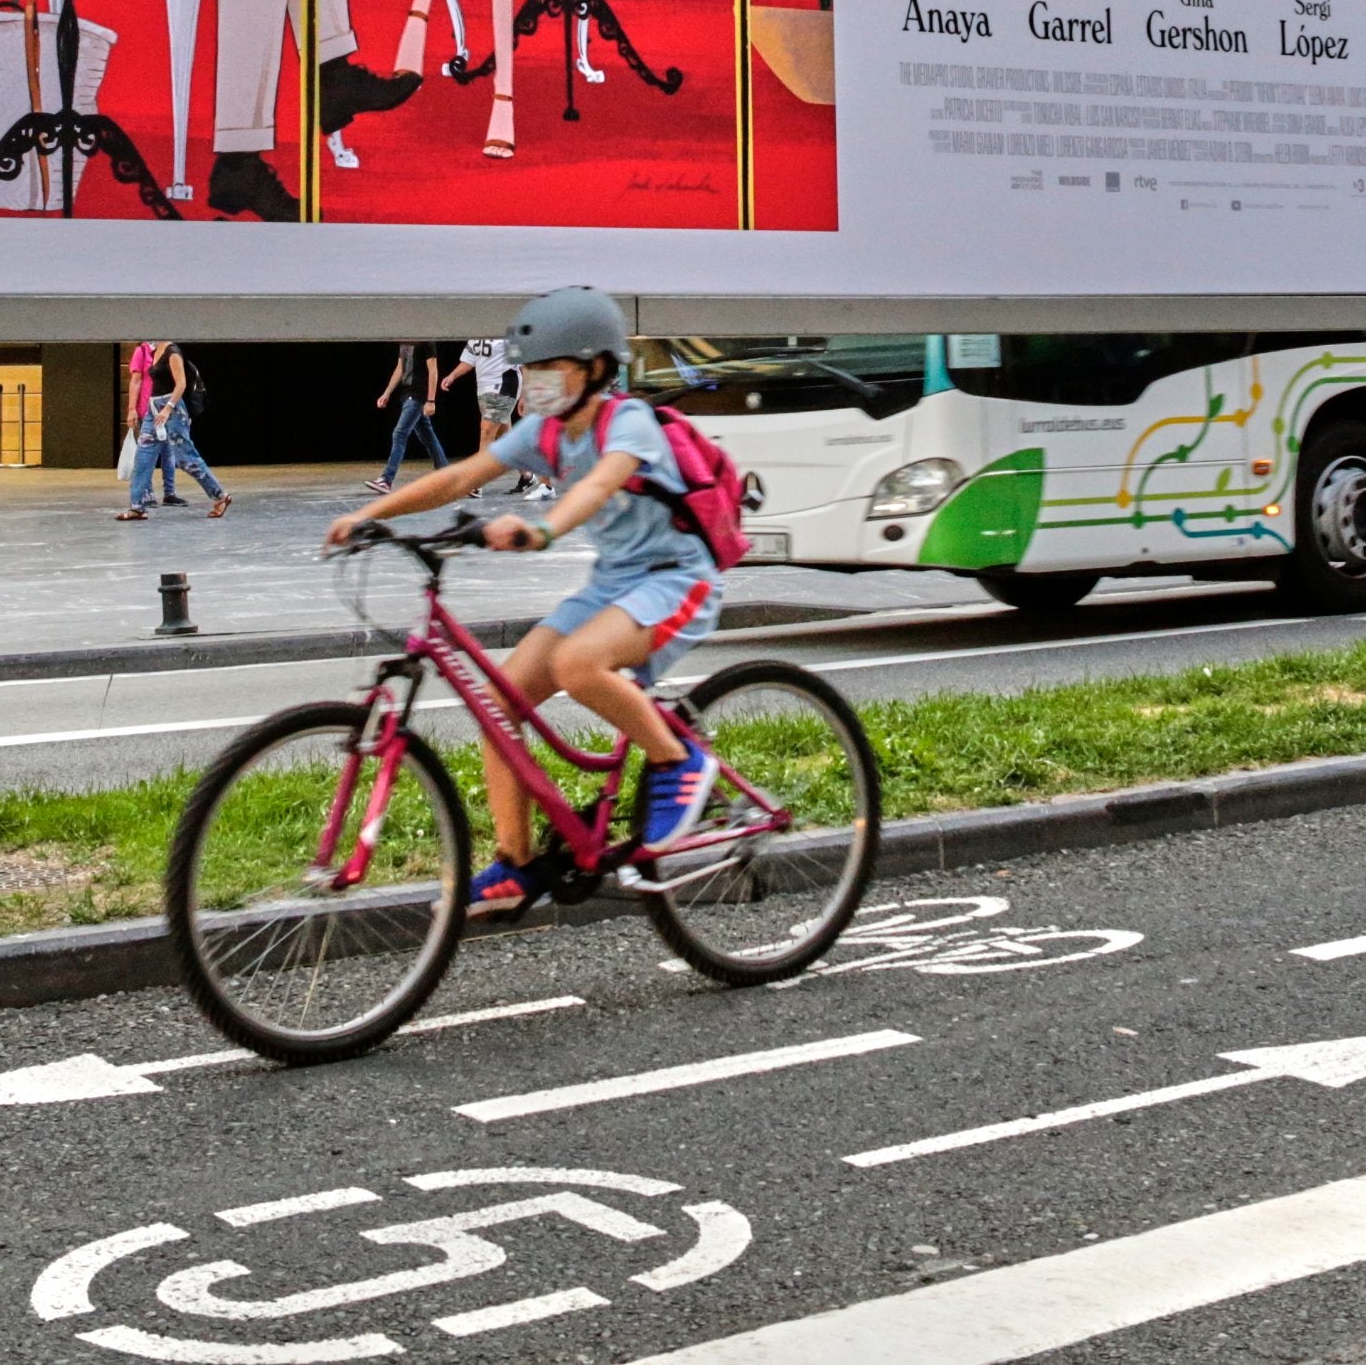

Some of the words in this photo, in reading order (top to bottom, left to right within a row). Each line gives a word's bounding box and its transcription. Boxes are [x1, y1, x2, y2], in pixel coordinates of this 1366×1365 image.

[1028, 1, 1113, 44] Garrel
[1146, 9, 1249, 54] Gershon
[1279, 19, 1349, 65] López
[1134, 175, 1157, 191] rtve
